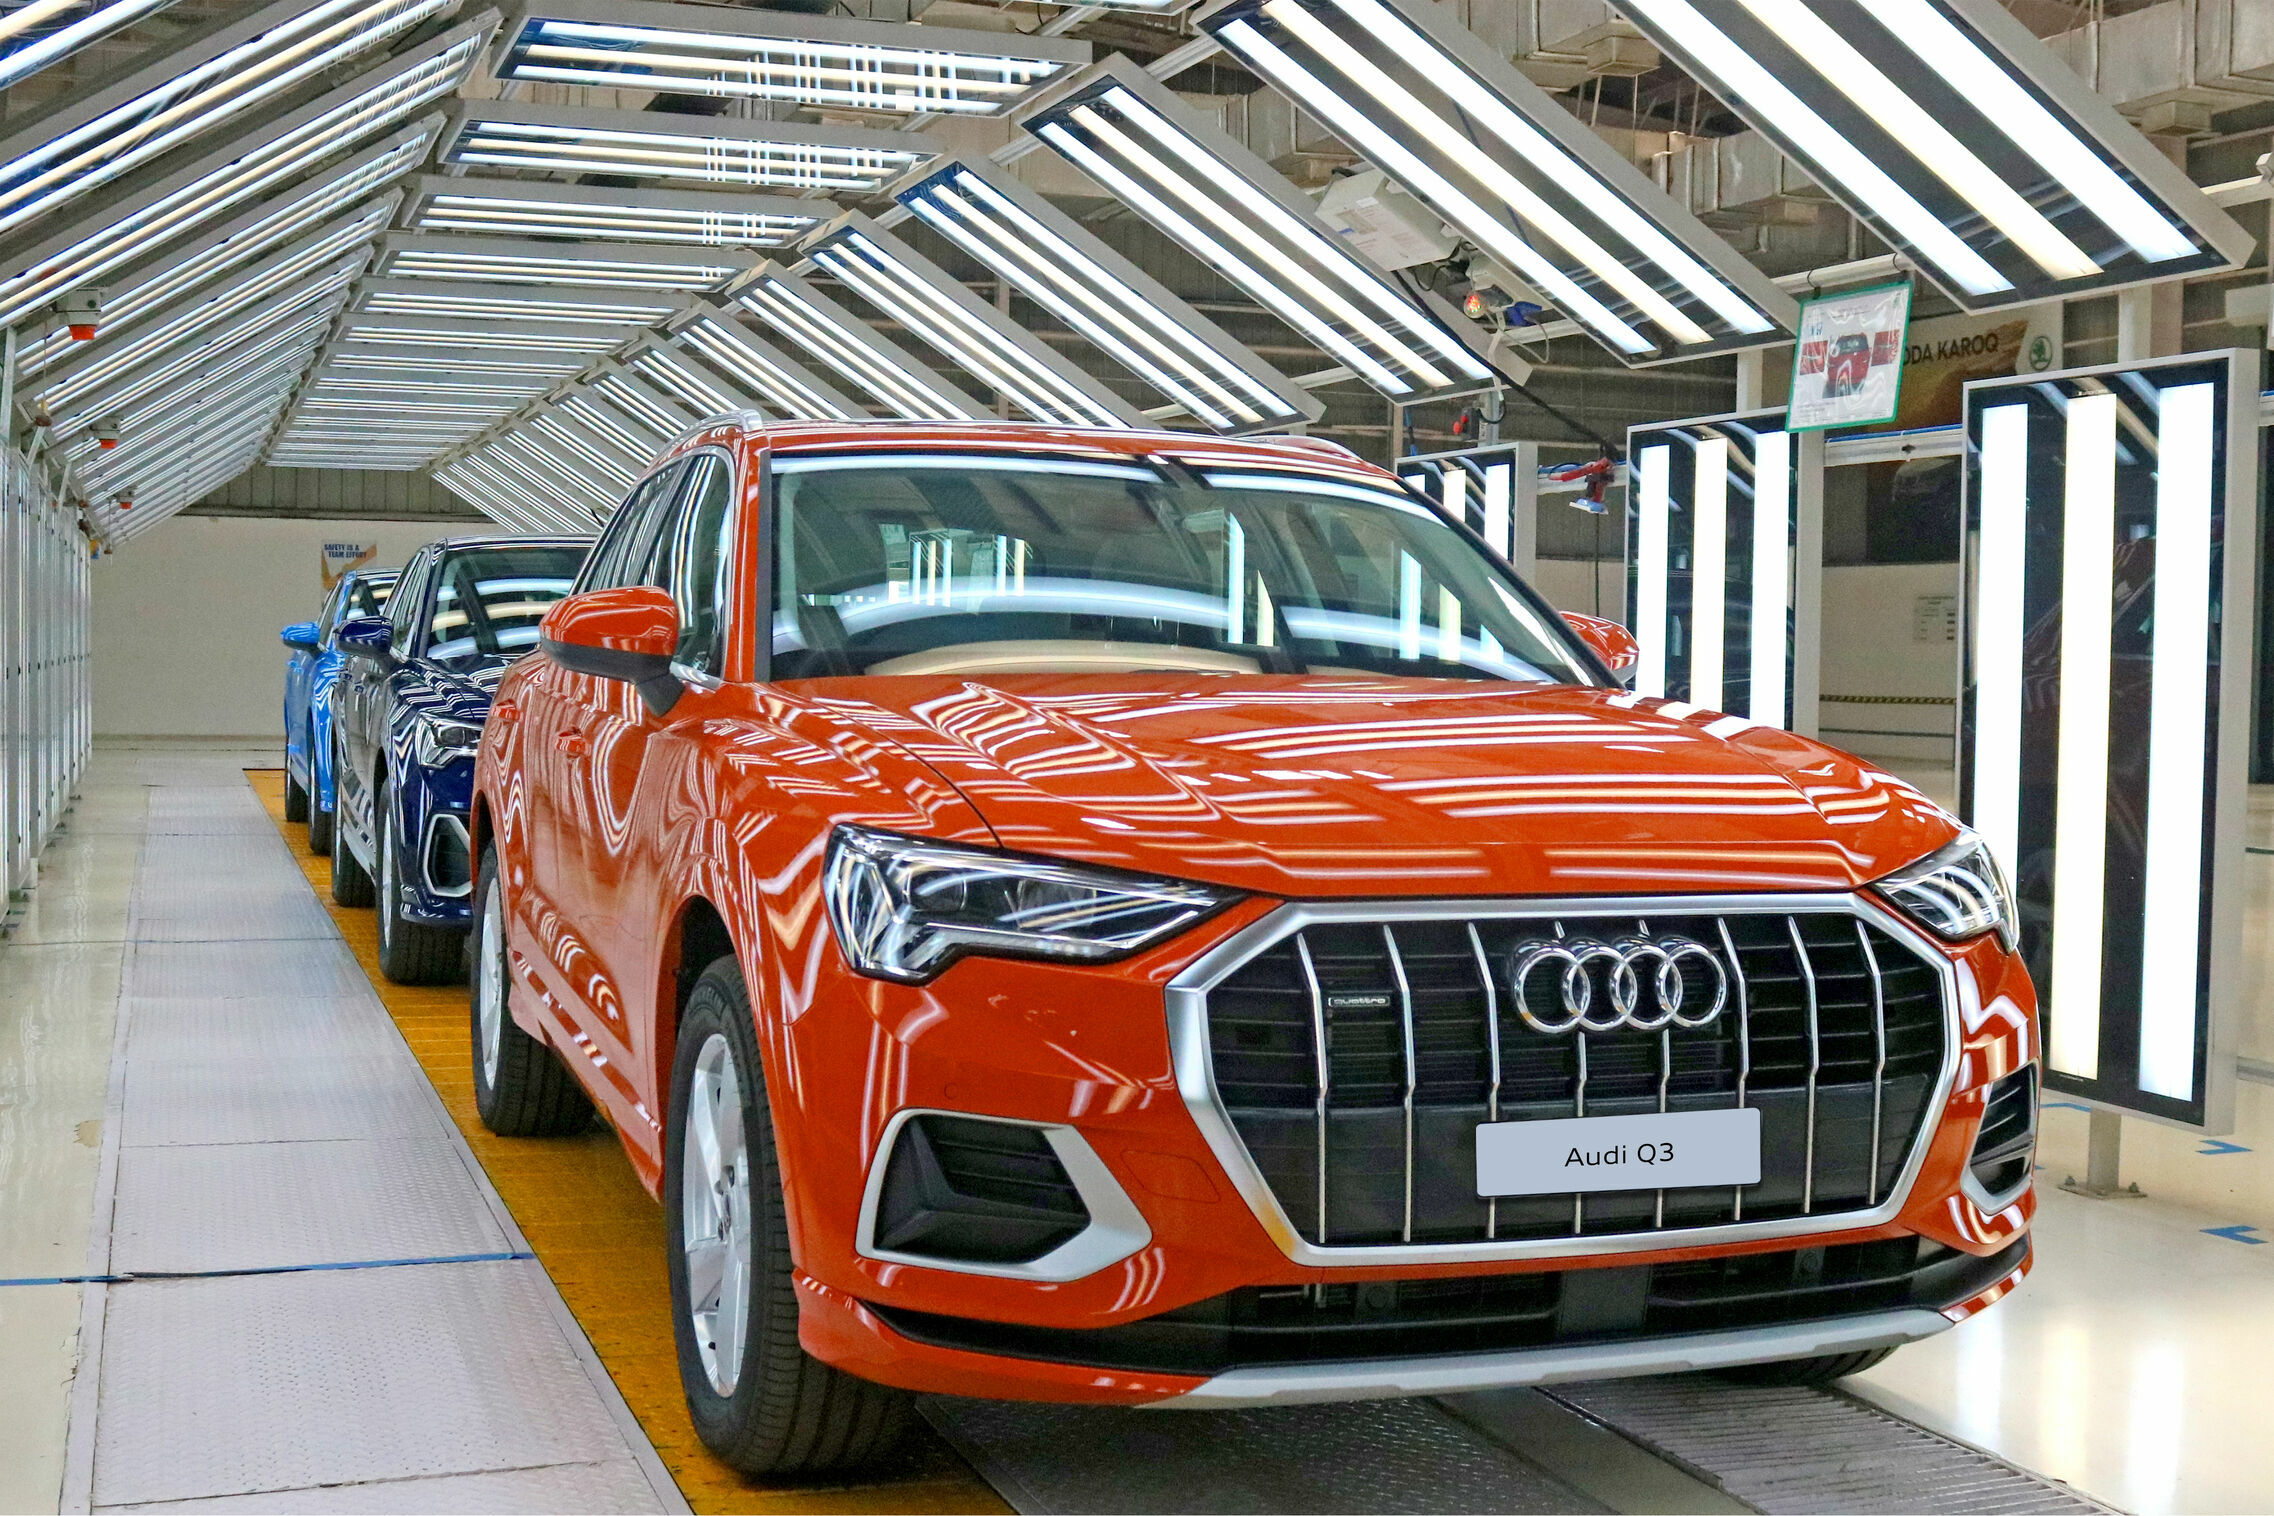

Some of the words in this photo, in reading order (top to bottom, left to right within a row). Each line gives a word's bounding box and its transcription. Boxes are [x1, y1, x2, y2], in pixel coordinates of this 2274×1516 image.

[1938, 333, 1999, 361] KAROQ
[1333, 997, 1386, 1006] quattro
[1565, 1144, 1626, 1168] Audi
[1637, 1142, 1674, 1166] Q3
